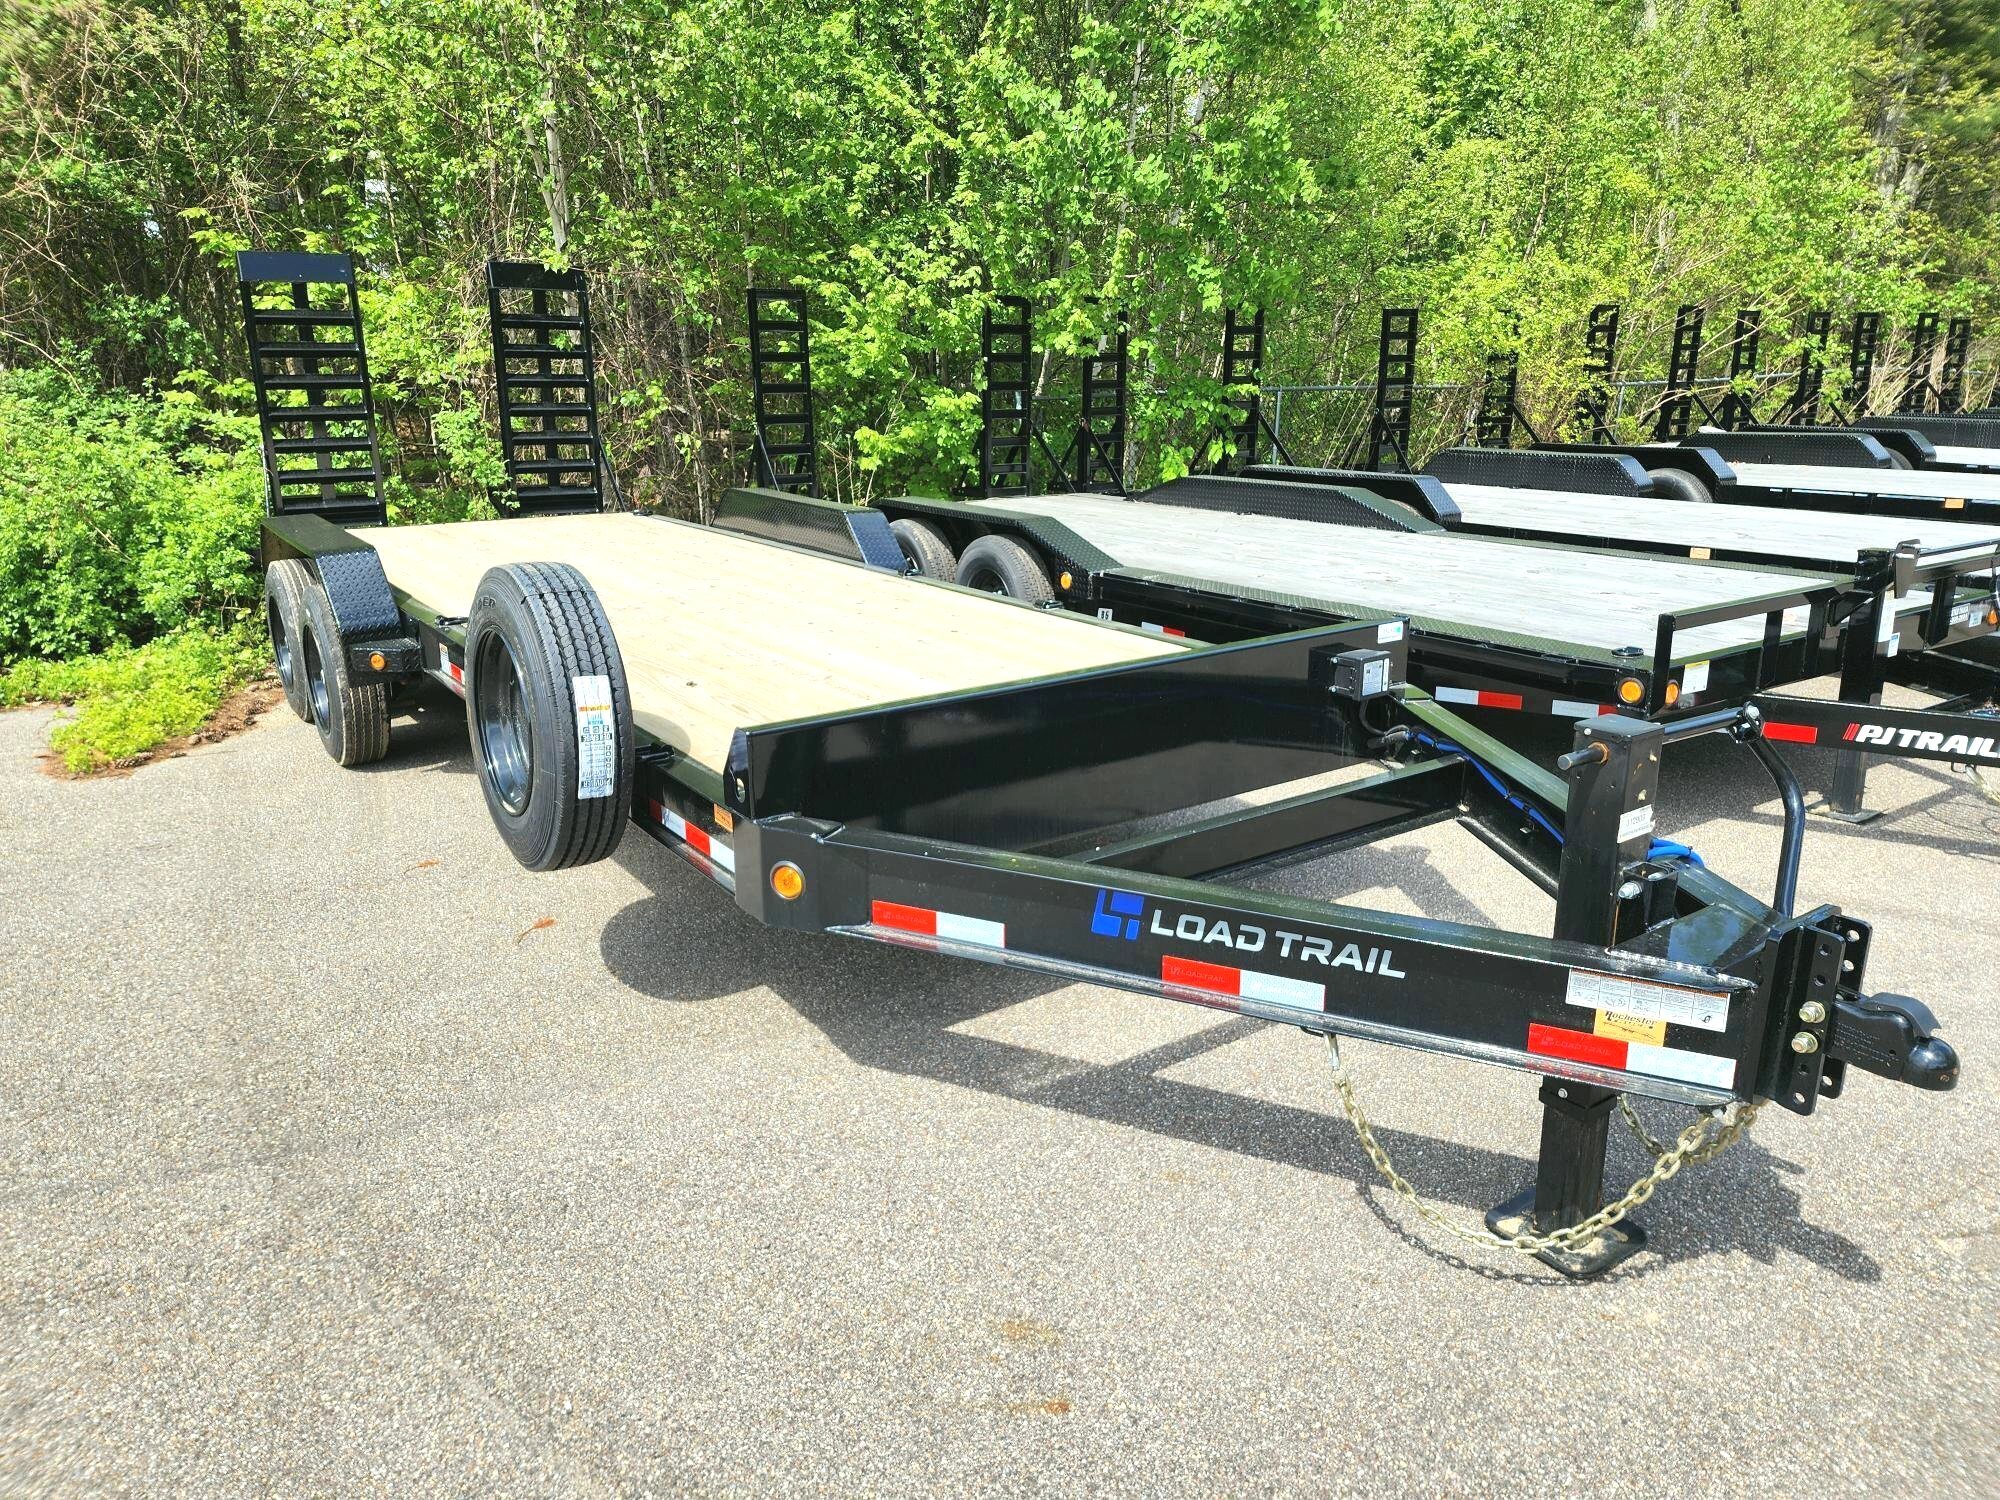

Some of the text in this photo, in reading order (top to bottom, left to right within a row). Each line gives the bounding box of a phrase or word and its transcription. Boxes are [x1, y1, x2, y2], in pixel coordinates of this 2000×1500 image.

[1855, 724, 2000, 759] PJ TRAIL
[1150, 909, 1406, 979] LOAD TRAIL
[1605, 1010, 1658, 1026] Rochester
